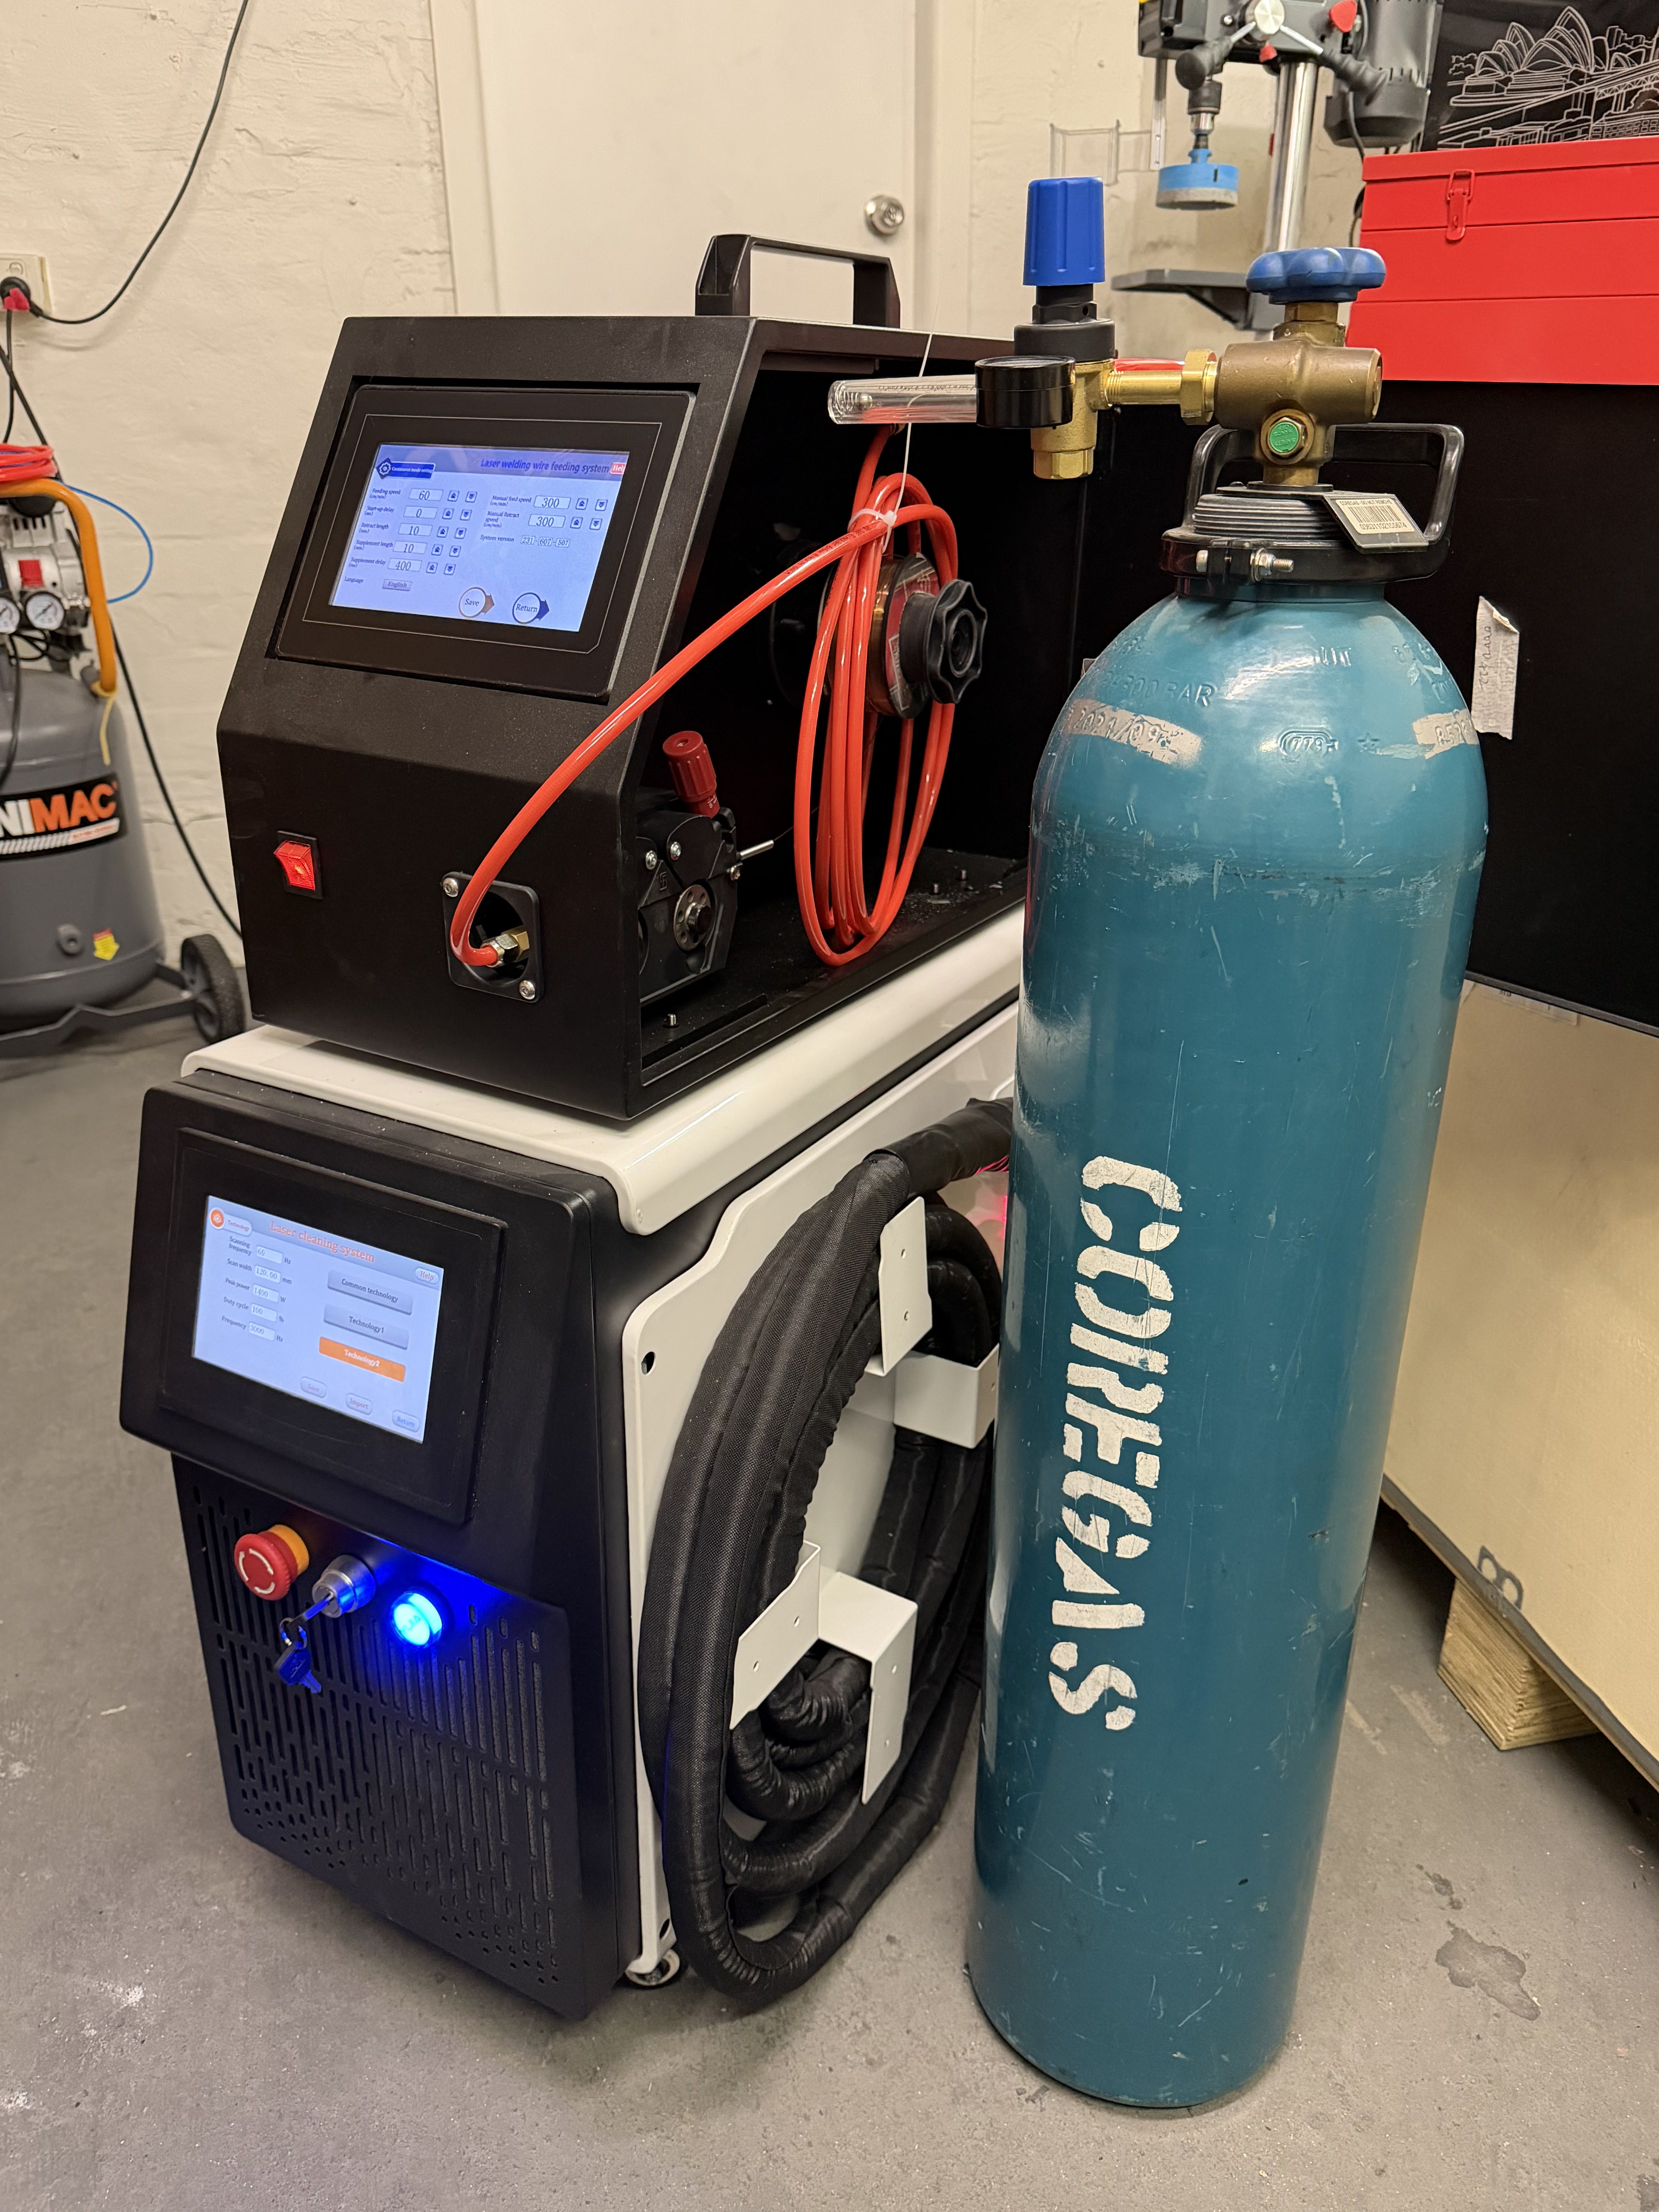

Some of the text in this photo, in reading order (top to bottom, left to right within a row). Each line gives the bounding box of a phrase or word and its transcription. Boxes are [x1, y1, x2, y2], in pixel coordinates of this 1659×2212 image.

[481, 459, 610, 474] Laser welding wire feeding system
[419, 490, 430, 500] 60
[542, 497, 560, 508] 300
[416, 508, 422, 518] 0
[536, 516, 554, 527] 300
[409, 526, 419, 535] 10
[403, 544, 414, 553] 10
[395, 560, 411, 571] 400
[515, 603, 538, 613] Return
[228, 1220, 250, 1232] Technology
[229, 1236, 251, 1249] Scanning
[270, 1221, 374, 1262] Laser cleaning system
[229, 1243, 252, 1256] frequency
[258, 1248, 265, 1256] 60
[227, 1259, 252, 1271] Scan width
[256, 1267, 277, 1279] 120.00
[420, 1271, 434, 1281] Help
[225, 1277, 250, 1290] Peak power
[254, 1287, 268, 1297] 1400
[342, 1279, 398, 1304] Common technology
[223, 1296, 249, 1310] Duty cycle
[252, 1306, 263, 1315] 100
[222, 1315, 247, 1330] Frequency
[349, 1316, 384, 1333] Technology1
[250, 1324, 264, 1334] 3000
[344, 1349, 380, 1367] Technology2
[307, 1384, 320, 1392] Save
[350, 1398, 368, 1410] Import
[397, 1415, 416, 1427] Return
[1049, 1156, 1182, 1731] COREGAS
